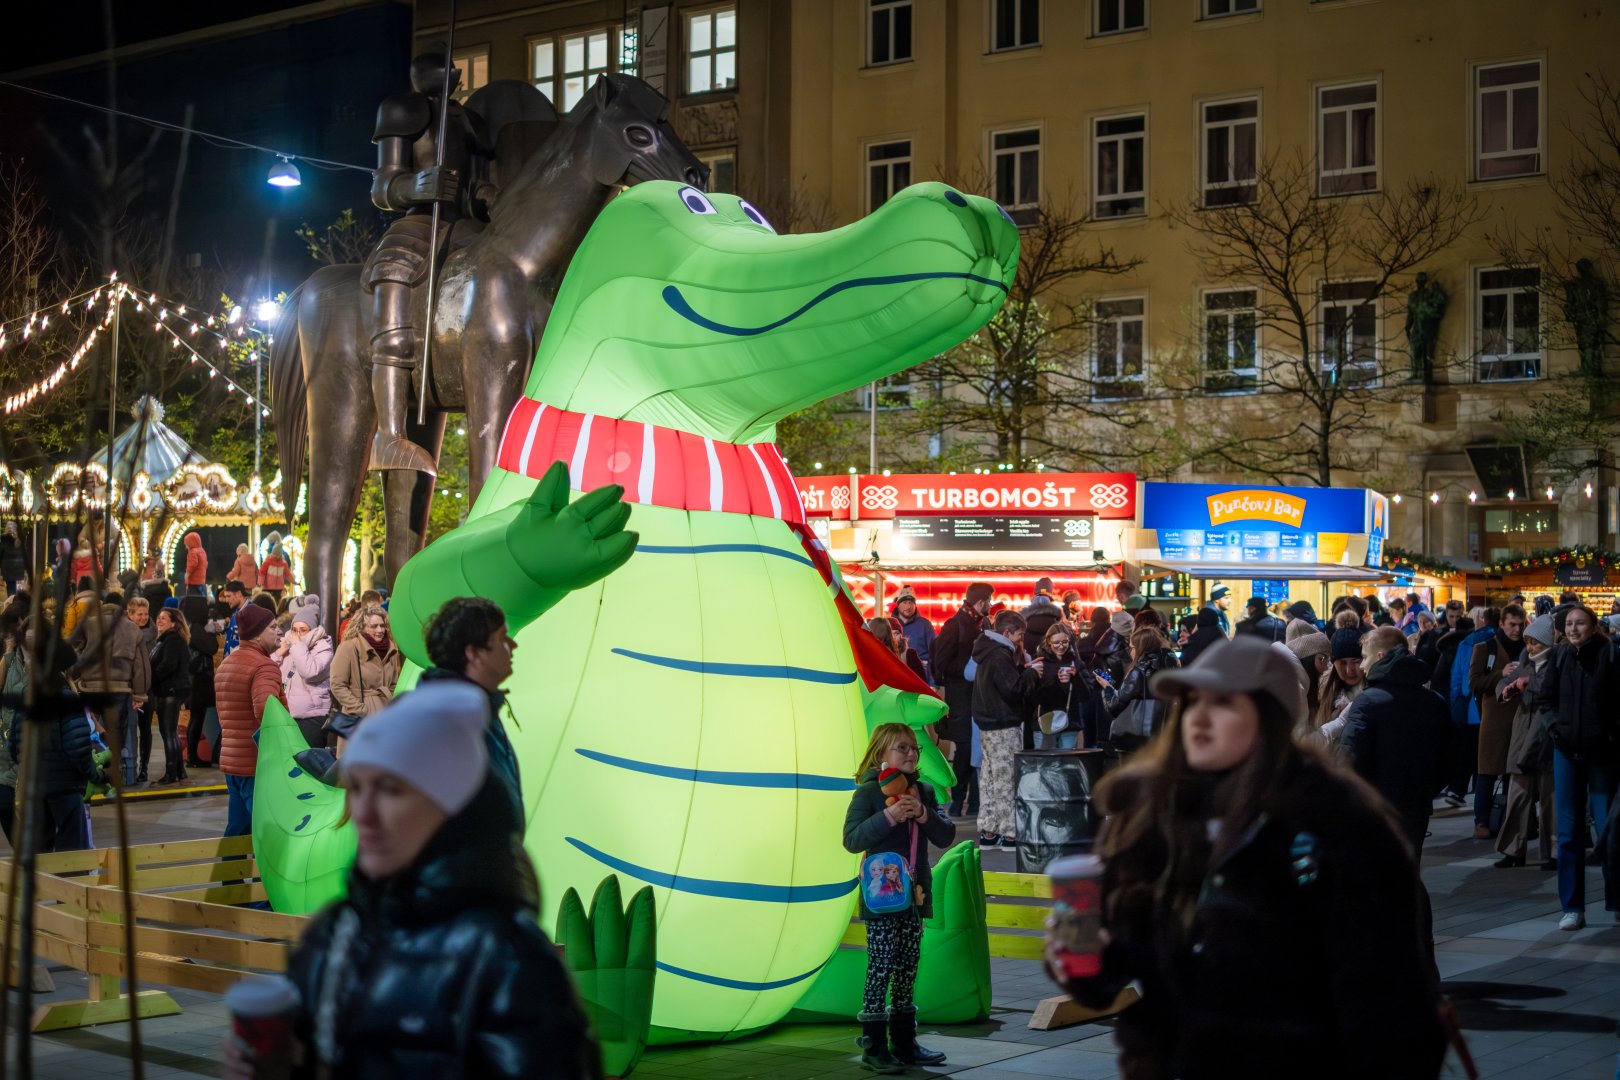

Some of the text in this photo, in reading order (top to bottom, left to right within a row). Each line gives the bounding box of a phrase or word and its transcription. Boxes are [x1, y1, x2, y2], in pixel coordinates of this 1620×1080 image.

[911, 482, 1076, 509] TURBOMOŠT
[1211, 496, 1301, 519] Punčový Bar
